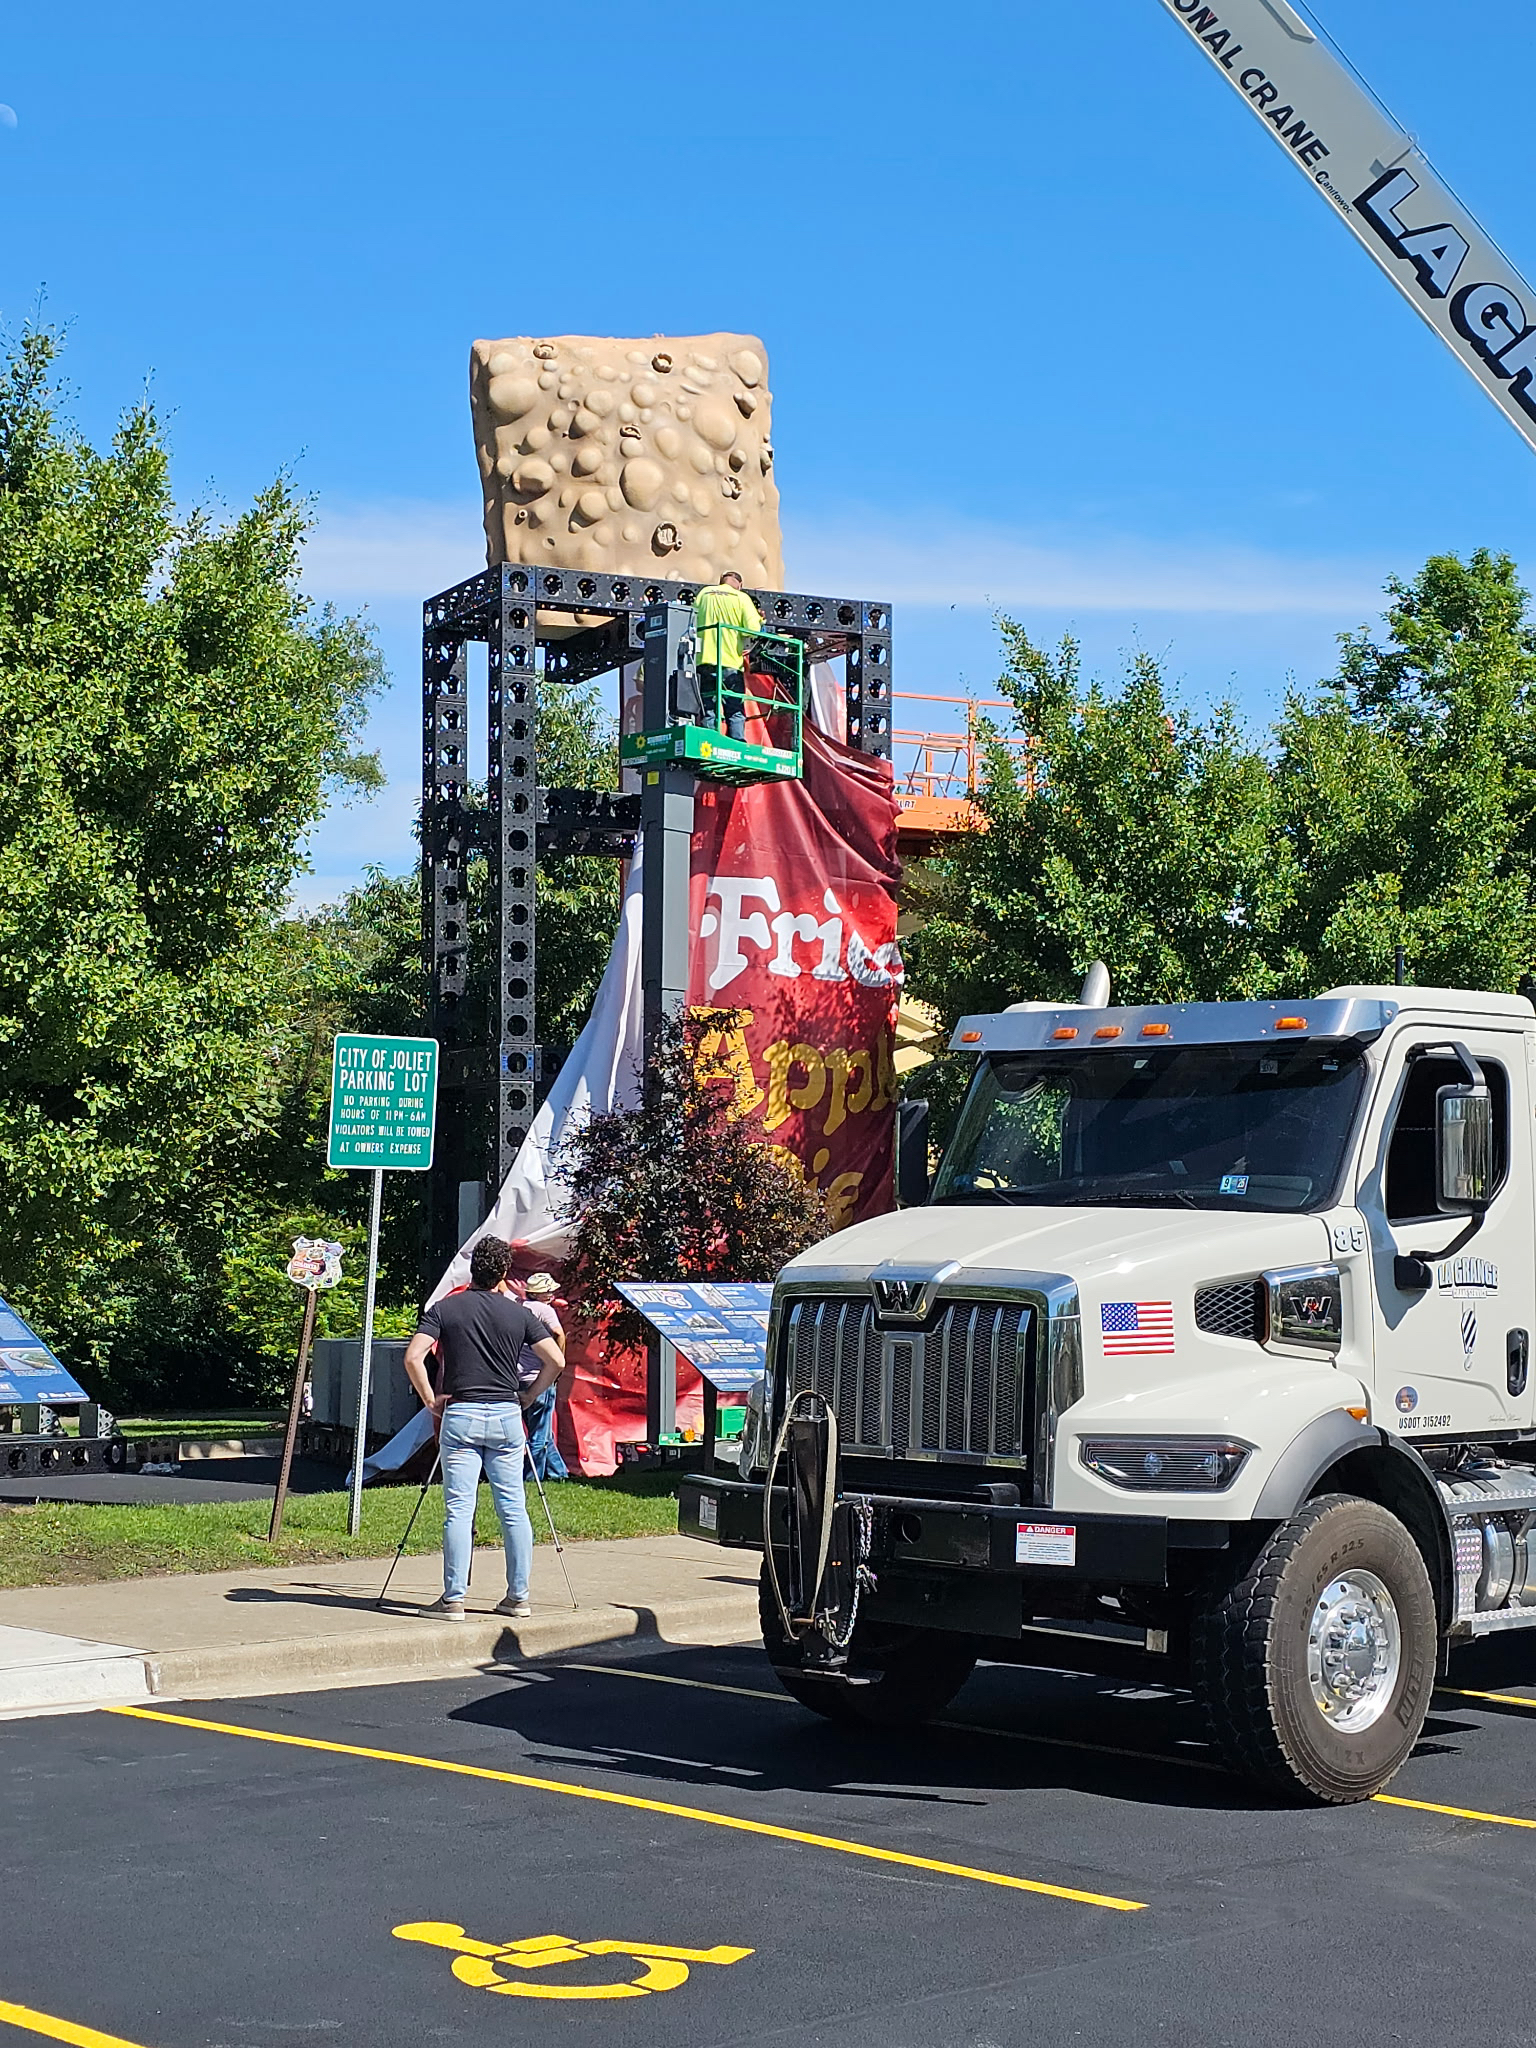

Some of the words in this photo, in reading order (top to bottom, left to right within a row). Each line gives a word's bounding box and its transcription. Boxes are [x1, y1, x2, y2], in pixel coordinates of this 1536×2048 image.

[1239, 67, 1331, 168] CRANE
[339, 1047, 368, 1068] CITY
[372, 1049, 388, 1070] OF
[389, 1050, 432, 1072] JOLIET
[339, 1069, 395, 1091] PARKING
[404, 1072, 428, 1093] LOT
[344, 1095, 355, 1106] NO
[359, 1095, 391, 1107] PARKING
[398, 1097, 424, 1109] DURING
[340, 1108, 365, 1120] HOURS
[370, 1109, 380, 1120] OF
[335, 1123, 375, 1136] VIOLATORS
[378, 1125, 394, 1137] WILL
[396, 1126, 405, 1137] BE
[407, 1126, 431, 1138] TOWED
[339, 1141, 350, 1153] AT
[354, 1142, 384, 1153] OWNERS
[389, 1142, 422, 1155] EXPENSE
[1333, 1224, 1366, 1253] 85
[1438, 1260, 1453, 1290] LA
[1453, 1256, 1498, 1290] GRANGE
[1398, 1416, 1422, 1430] USDOT
[1422, 1414, 1452, 1428] 3152492
[1034, 1526, 1066, 1535] DANGER
